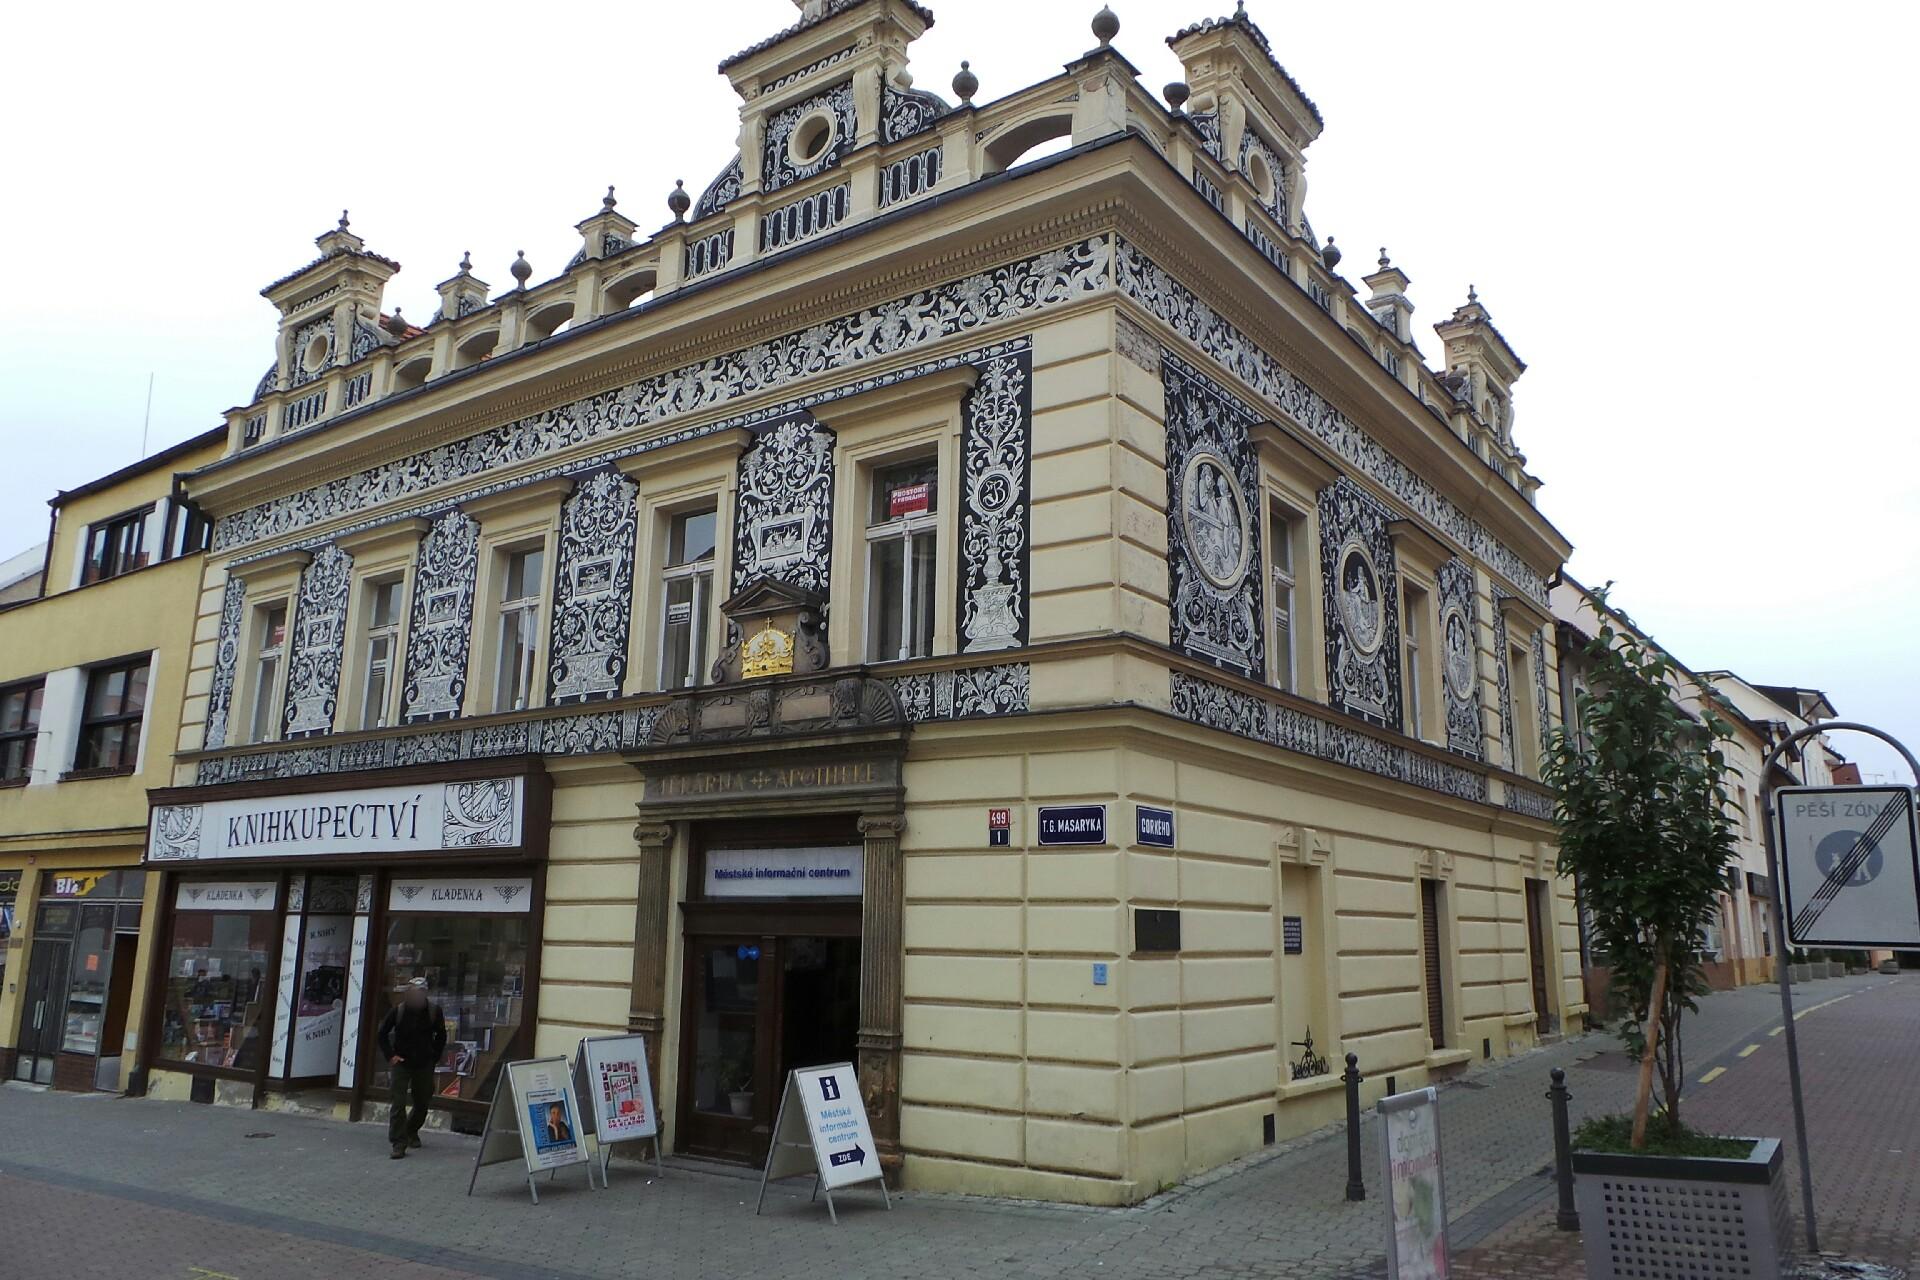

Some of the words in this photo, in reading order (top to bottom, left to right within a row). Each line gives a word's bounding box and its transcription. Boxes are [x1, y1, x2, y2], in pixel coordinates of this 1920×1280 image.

[1796, 800, 1836, 817] PĚŠÍ
[1843, 800, 1889, 817] ZÓN
[227, 794, 424, 848] KNIHKUPECTVÍ
[991, 812, 1006, 825] 499
[1057, 818, 1102, 833] MASARYKA
[1141, 816, 1171, 837] GORKÉHO
[715, 866, 753, 879] Městské
[755, 866, 805, 878] informační
[808, 867, 851, 878] centrum
[206, 889, 243, 902] KLADENKA
[431, 888, 483, 901] KLADENKA
[310, 926, 337, 939] KNIHY
[305, 1025, 333, 1041] KNIHY
[820, 1106, 852, 1119] Městské
[819, 1119, 858, 1134] informační
[828, 1131, 859, 1144] centrum
[838, 1153, 852, 1163] ZDE
